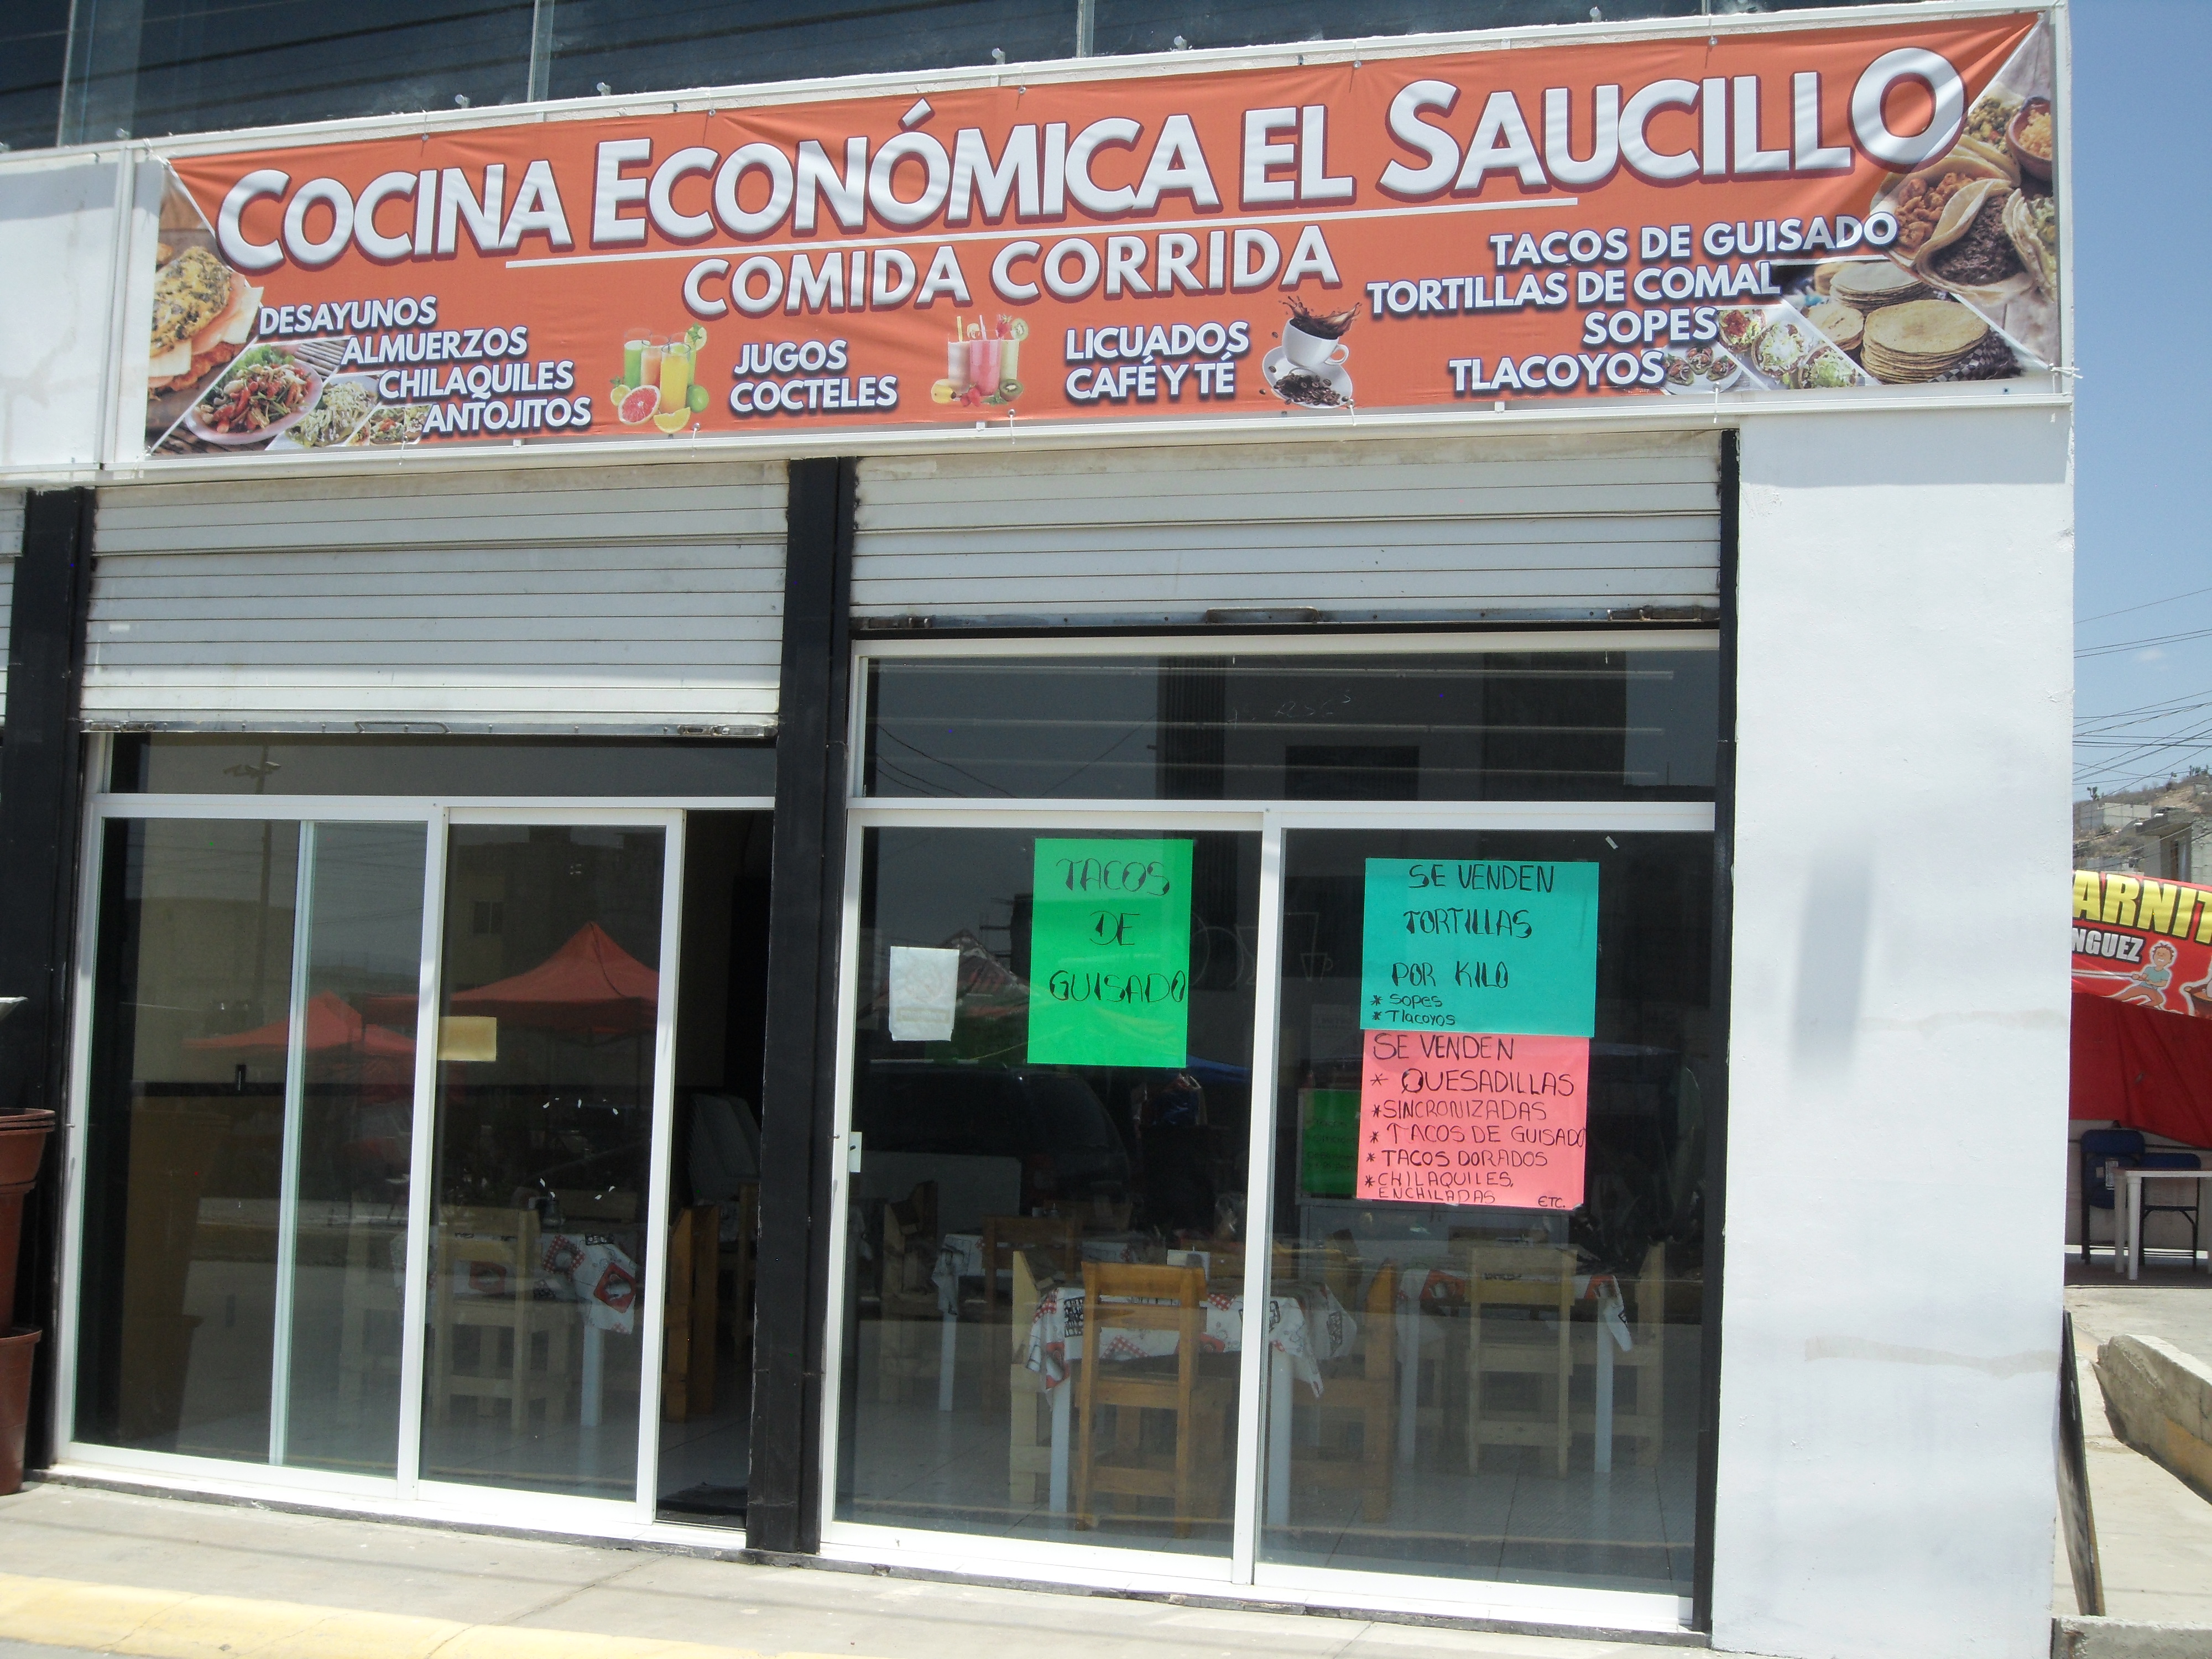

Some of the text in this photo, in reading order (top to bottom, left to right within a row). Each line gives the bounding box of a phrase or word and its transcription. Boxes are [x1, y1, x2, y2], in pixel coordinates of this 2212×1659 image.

[220, 48, 1965, 271] COCINA ECONÓMICA EL SAUCILLO
[1490, 212, 1898, 266] TACOS DE GUISADO
[684, 226, 1340, 315] COMIDA CORRIDA
[1366, 262, 1781, 314] TORTILLAS DE COMAL
[259, 296, 437, 336] DESAYUNOS
[1582, 307, 1718, 345] SOPES
[341, 326, 528, 366] ALMUERZOS
[734, 340, 848, 375] JUGOS
[1067, 321, 1249, 360] LICUADOS
[379, 361, 574, 402] CHILAQUILES
[1066, 352, 1235, 399] CAFÉ Y TÉ
[1449, 351, 1666, 391] TLACOYOS
[730, 375, 899, 414] COCTELES
[422, 397, 591, 434] ANTOJITOS
[1056, 858, 1170, 896] TACOS
[1408, 864, 1554, 893] SE VENDEN
[1089, 910, 1141, 946] DE
[1403, 907, 1532, 939] TORTILLAS
[1049, 969, 1186, 1004] GUISADO
[1391, 960, 1509, 989] POR KILO
[1373, 1032, 1515, 1061] SE VENDEN
[1401, 1068, 1575, 1097] QUESADILLAS
[1383, 1099, 1547, 1121] SINCRONIZADAS
[1386, 1122, 1586, 1148] TACOS DE GUISADO
[1381, 1149, 1548, 1167] TACOS DORADOS
[1378, 1186, 1495, 1204] ENCHILADAS
